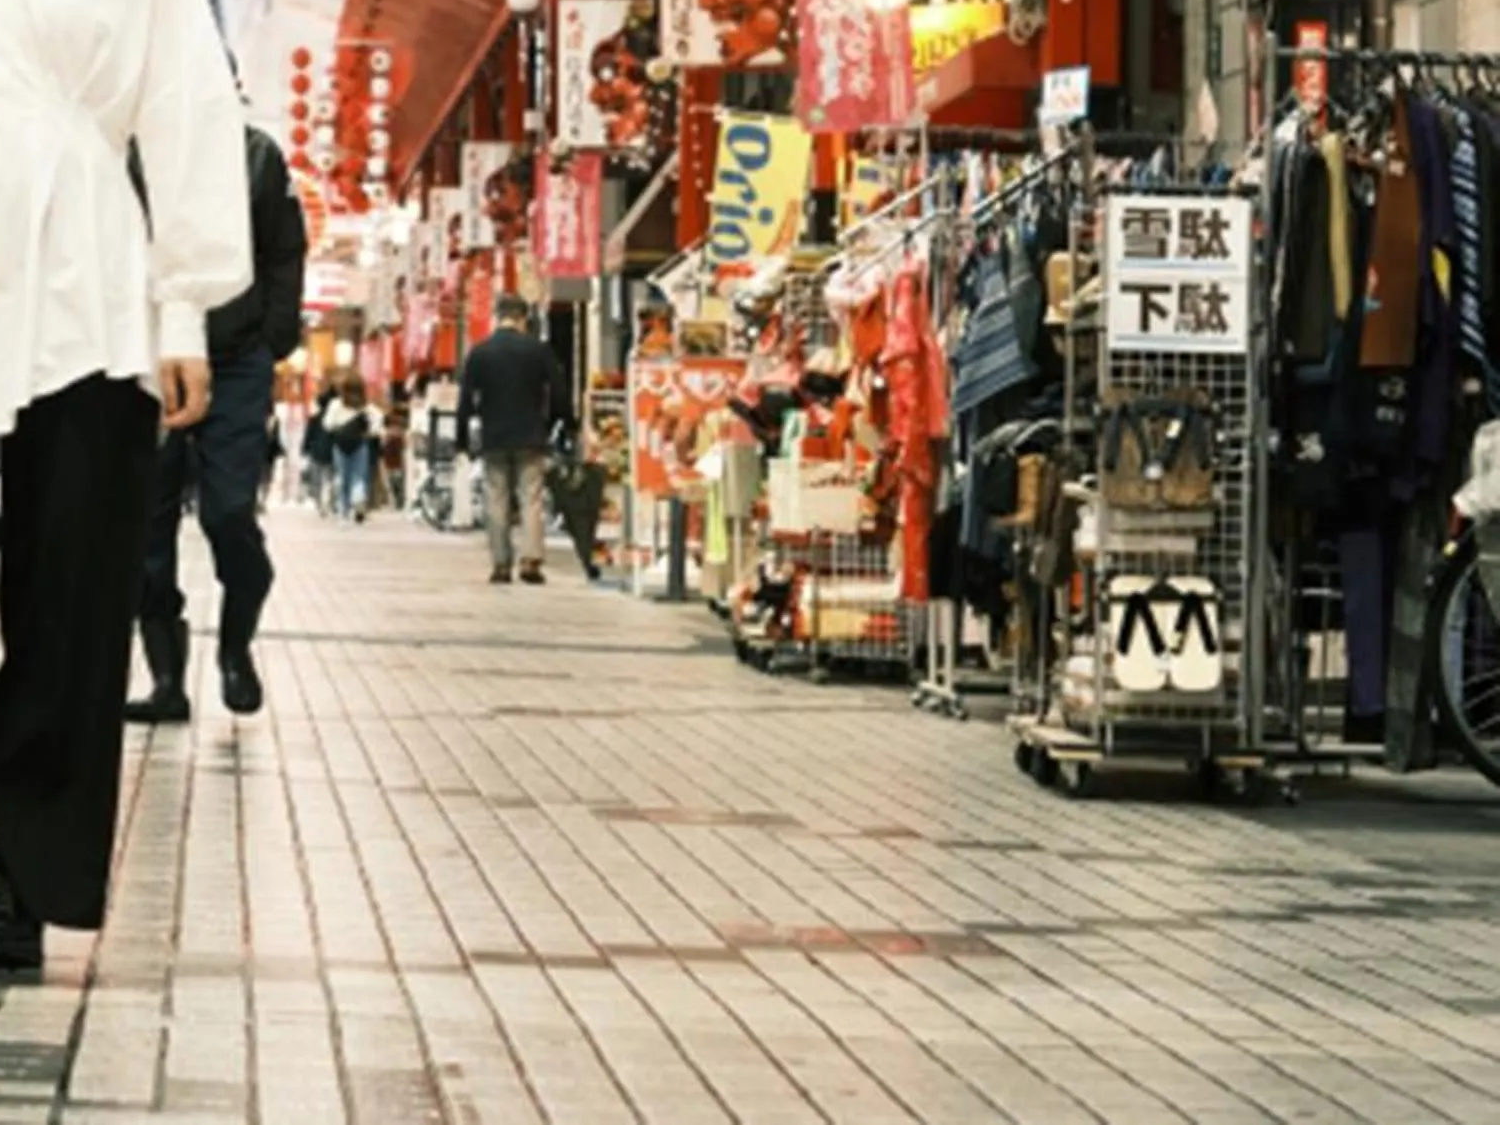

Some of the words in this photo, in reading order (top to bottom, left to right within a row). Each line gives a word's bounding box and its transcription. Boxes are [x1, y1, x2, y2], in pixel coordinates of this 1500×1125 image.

[710, 125, 772, 271] Orio
[1122, 206, 1231, 260] 雪駄
[1119, 281, 1231, 334] 下駄
